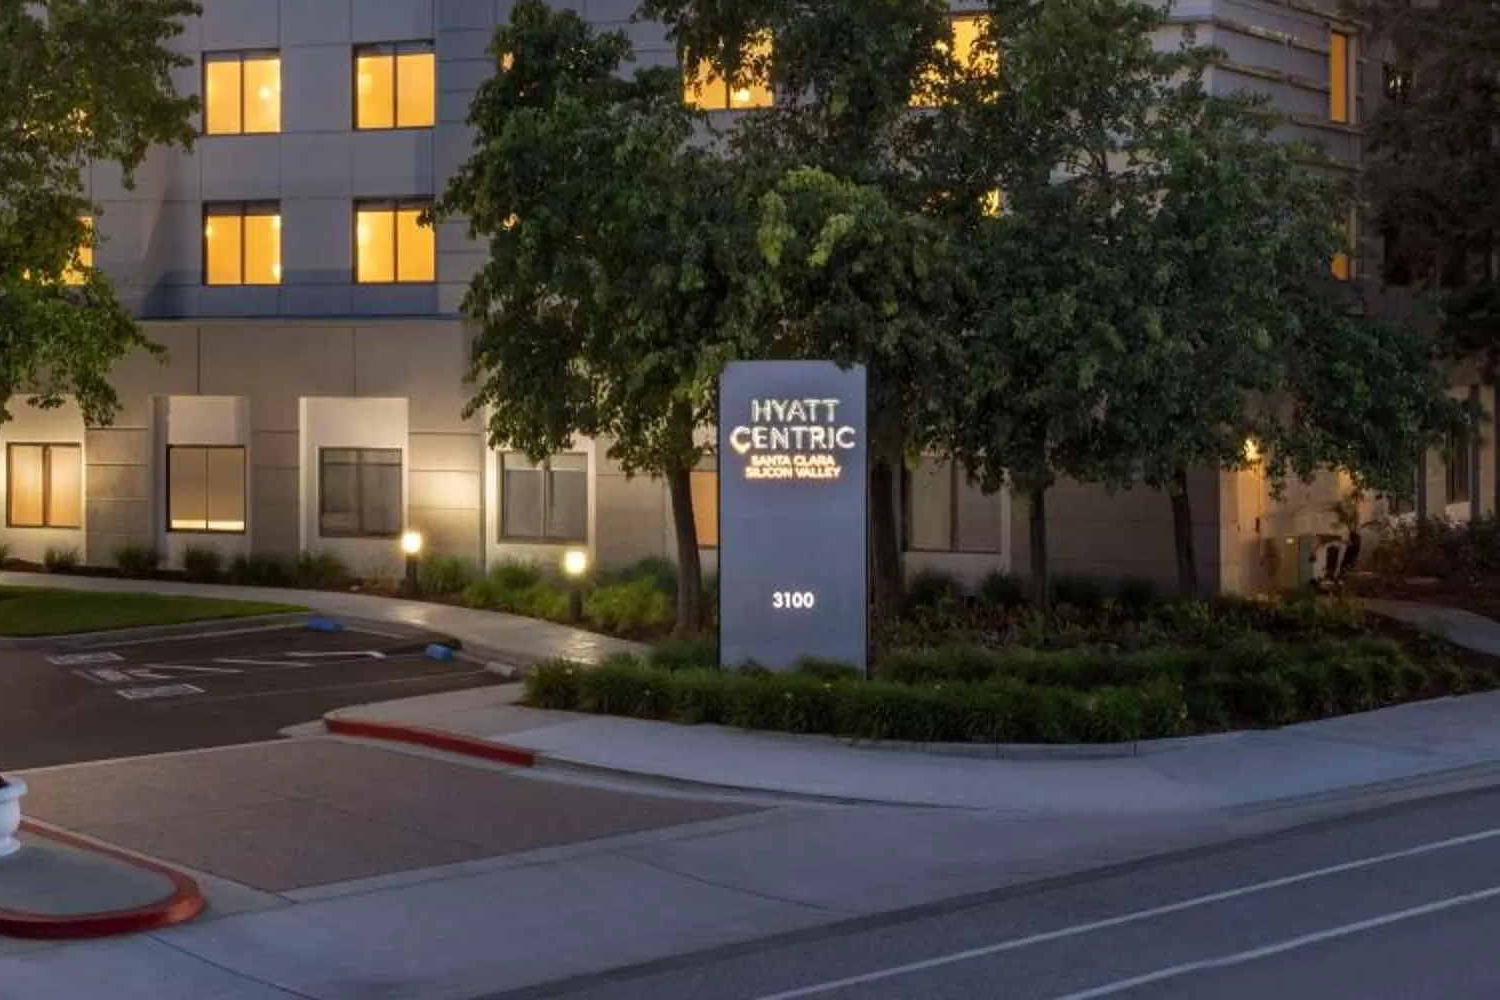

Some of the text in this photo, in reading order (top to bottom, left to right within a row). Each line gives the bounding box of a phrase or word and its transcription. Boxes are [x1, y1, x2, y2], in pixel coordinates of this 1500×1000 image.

[752, 400, 839, 422] HYATT
[730, 426, 855, 454] CENTRIC
[751, 455, 836, 467] SANTA CLARA
[745, 465, 841, 479] SILICON VALLEY
[772, 592, 814, 608] 3100
